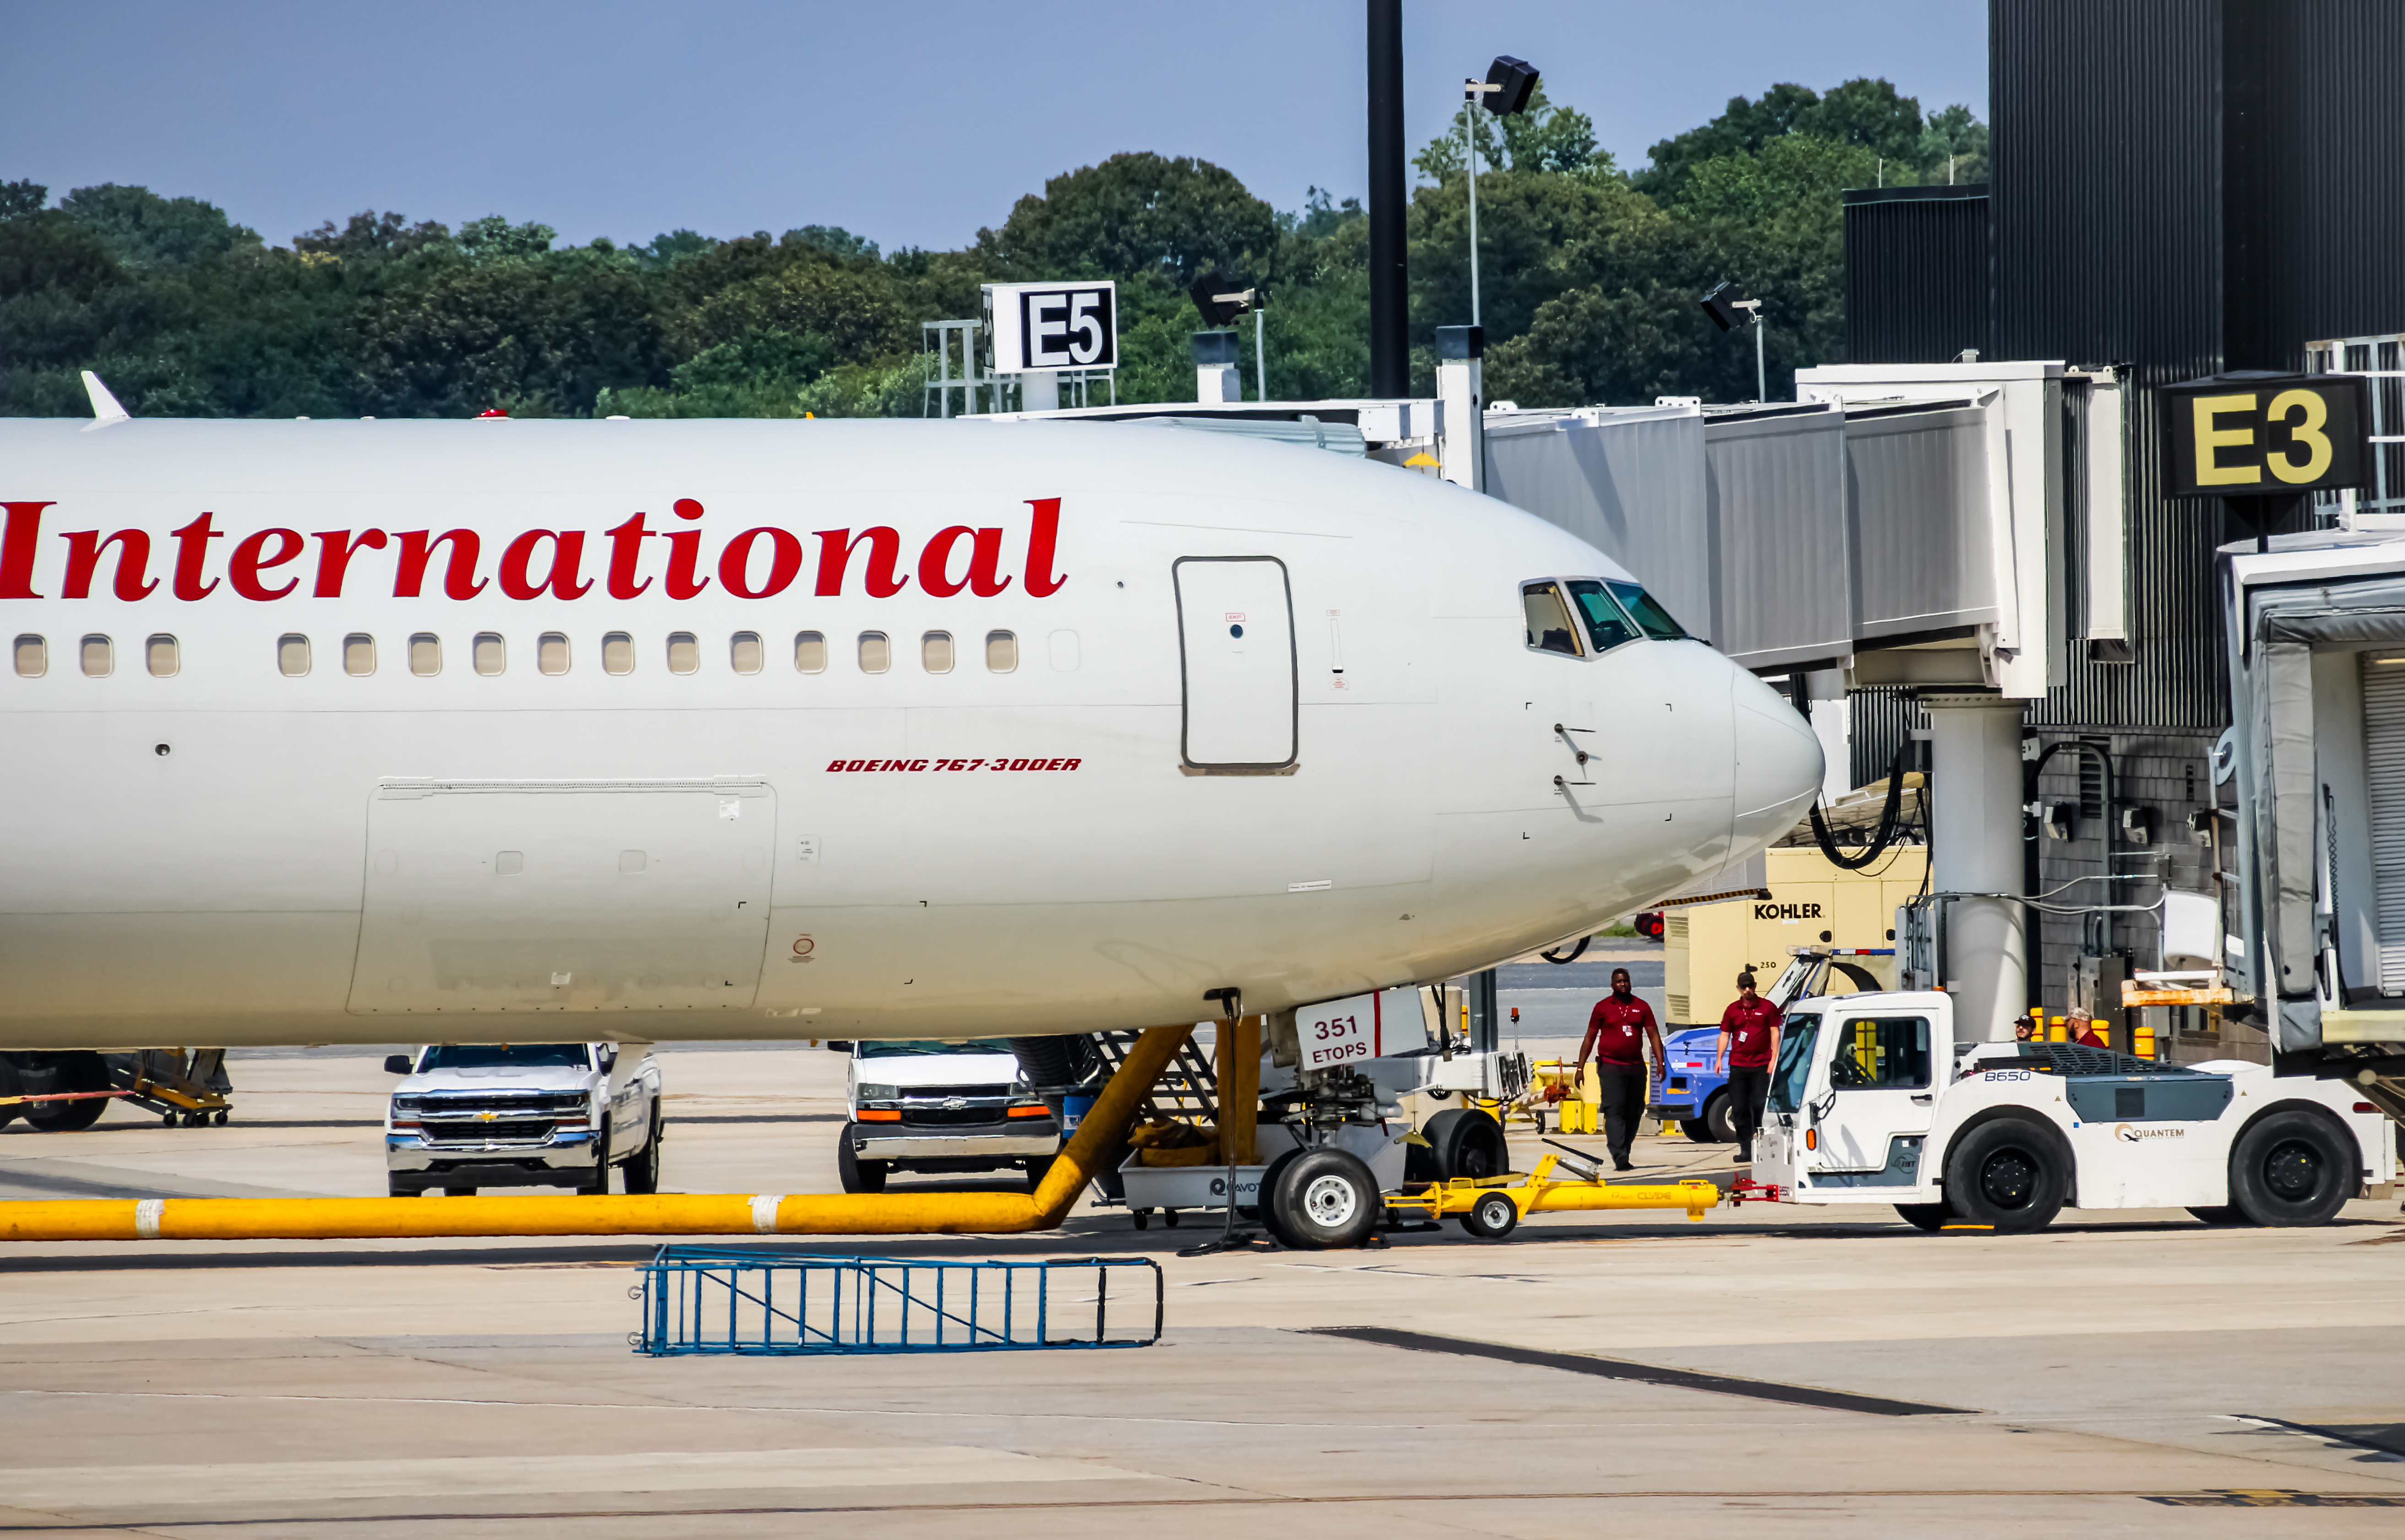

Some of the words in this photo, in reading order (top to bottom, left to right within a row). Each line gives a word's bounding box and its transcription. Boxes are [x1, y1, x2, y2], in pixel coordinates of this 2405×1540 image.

[1029, 292, 1103, 366] E5
[2193, 389, 2333, 485] E3
[0, 497, 1069, 601] International
[825, 759, 929, 772] BOEING
[932, 758, 1082, 771] 767-300ER
[1754, 904, 1822, 919] KOHLER
[1314, 1015, 1357, 1040] 351
[1312, 1042, 1367, 1063] ETOPS
[1985, 1071, 2031, 1082] B650
[2134, 1129, 2184, 1137] QUANTEM
[1637, 1192, 1672, 1200] CLYDE
